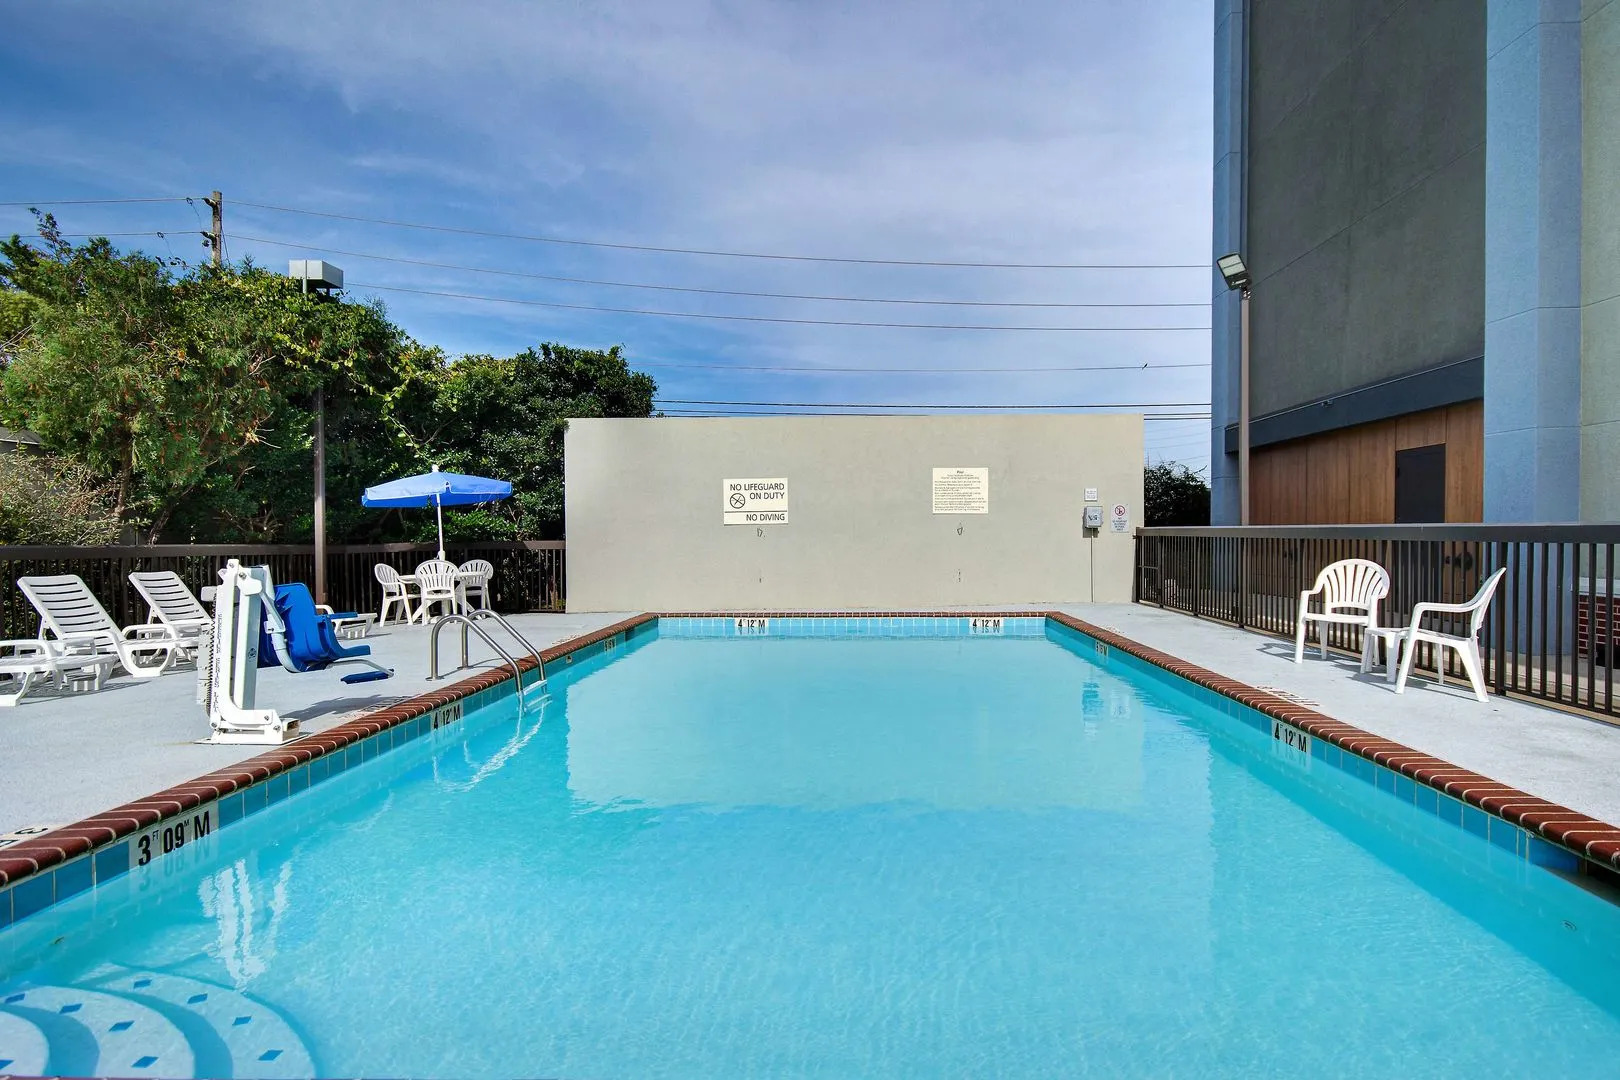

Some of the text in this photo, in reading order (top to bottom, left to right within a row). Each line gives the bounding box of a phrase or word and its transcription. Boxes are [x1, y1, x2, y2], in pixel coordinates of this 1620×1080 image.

[729, 482, 785, 491] NO LIFEGUARD
[749, 491, 785, 500] ON DUTY
[745, 513, 786, 521] NO DIVING
[758, 619, 766, 628] M
[993, 619, 1001, 628] M
[453, 704, 461, 721] M
[1298, 733, 1307, 753] M
[193, 810, 211, 841] M
